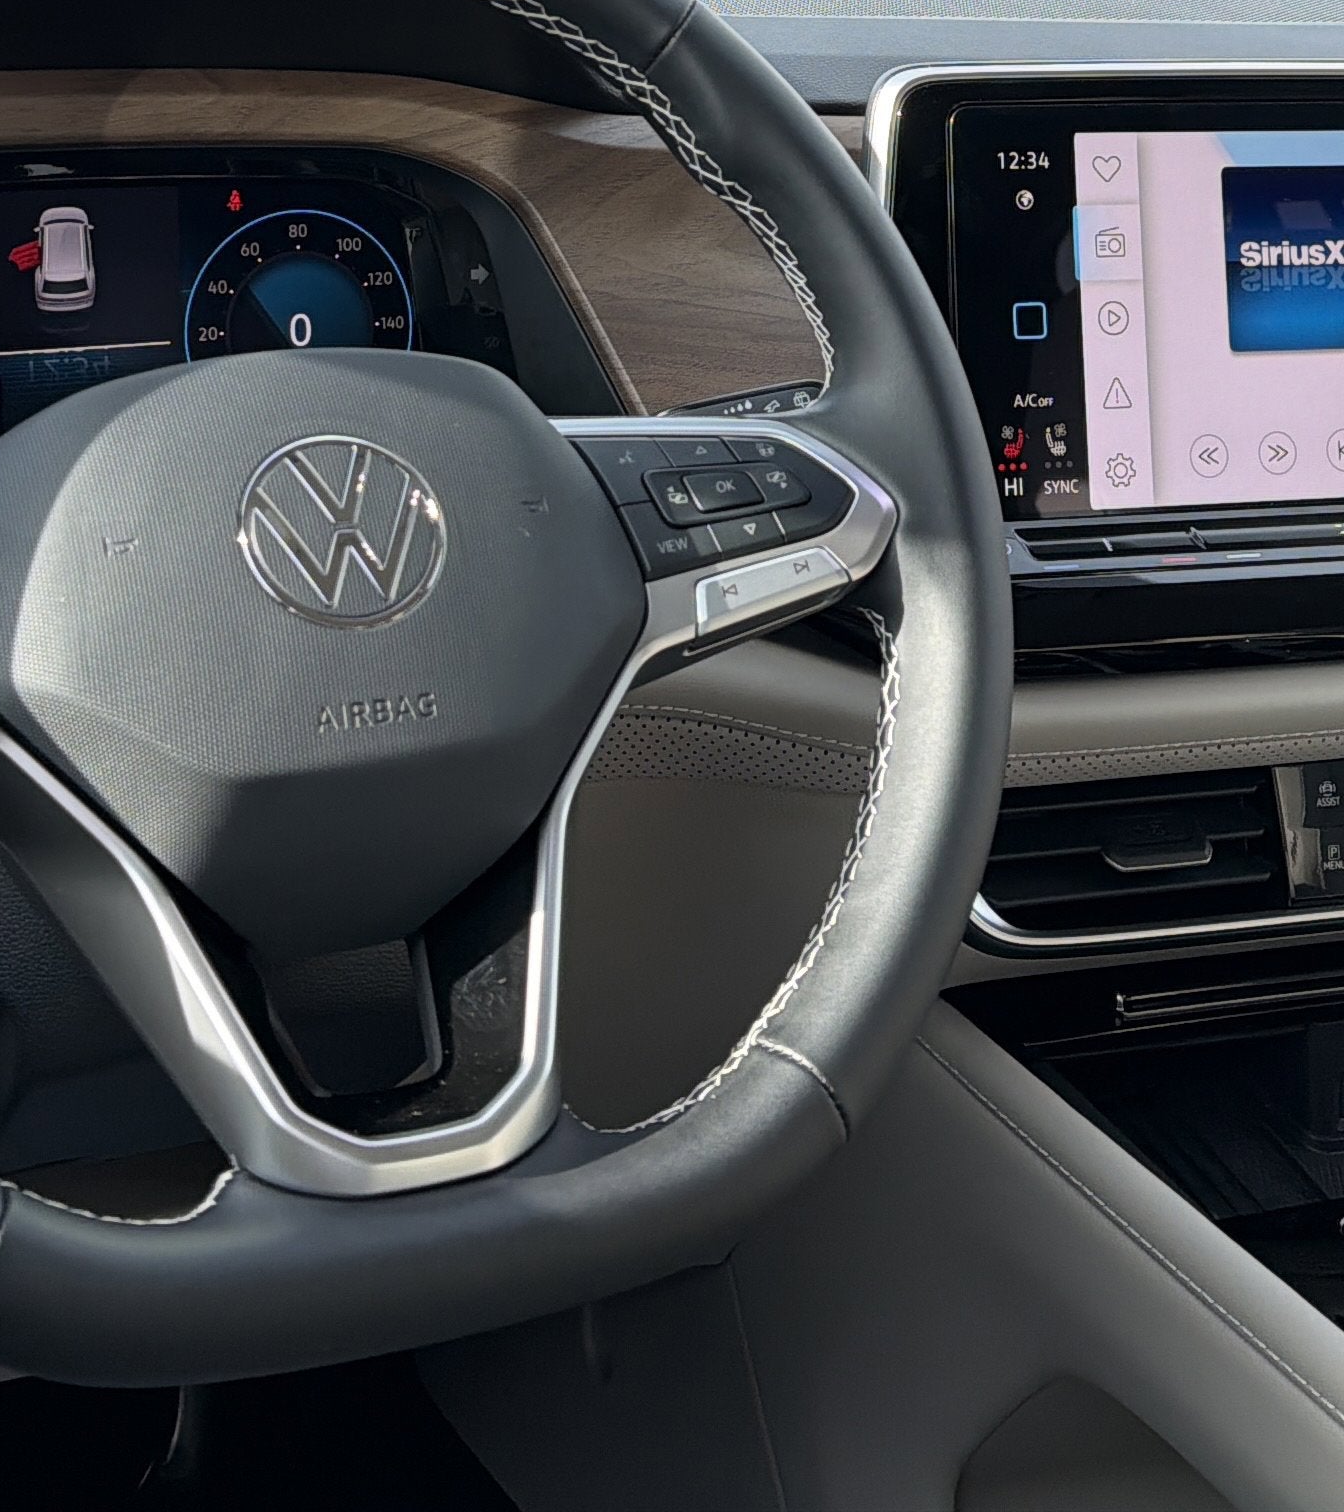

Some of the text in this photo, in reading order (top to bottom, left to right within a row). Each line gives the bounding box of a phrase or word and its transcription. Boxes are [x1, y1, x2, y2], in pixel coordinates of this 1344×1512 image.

[996, 151, 1050, 170] 12:34
[288, 224, 308, 238] 80
[240, 242, 261, 257] 60
[336, 238, 363, 253] 100
[367, 272, 394, 287] 120
[207, 280, 229, 295] 40
[288, 313, 313, 347] 0
[380, 316, 405, 330] 140
[197, 327, 219, 342] 20
[1014, 394, 1054, 408] A/C OFF
[715, 479, 737, 494] OK
[1004, 477, 1023, 497] HI
[1044, 479, 1079, 495] SYNC
[656, 537, 688, 554] VIEW
[318, 692, 438, 734] AIRBAG
[1316, 796, 1341, 808] ASSIST
